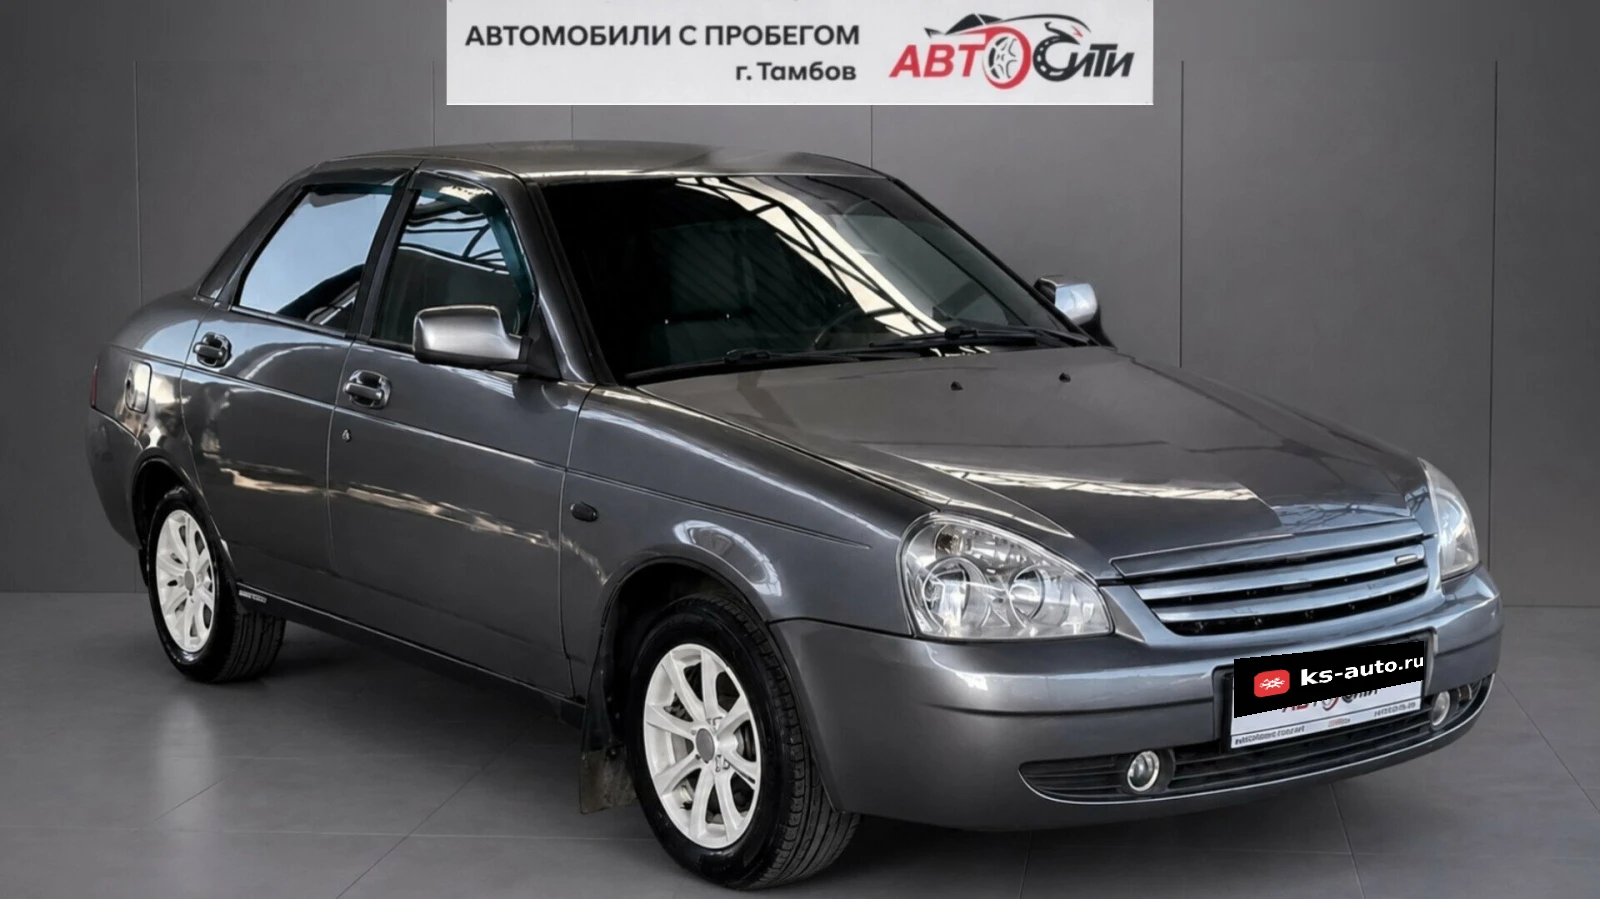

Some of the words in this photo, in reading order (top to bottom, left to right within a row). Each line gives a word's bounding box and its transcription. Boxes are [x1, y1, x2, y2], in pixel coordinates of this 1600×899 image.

[464, 25, 671, 46] АВТОМОБИЛИ
[678, 25, 697, 46] С
[705, 24, 860, 46] ПРОБЕГОМ
[735, 65, 752, 82] г.
[757, 61, 857, 82] Тамбов
